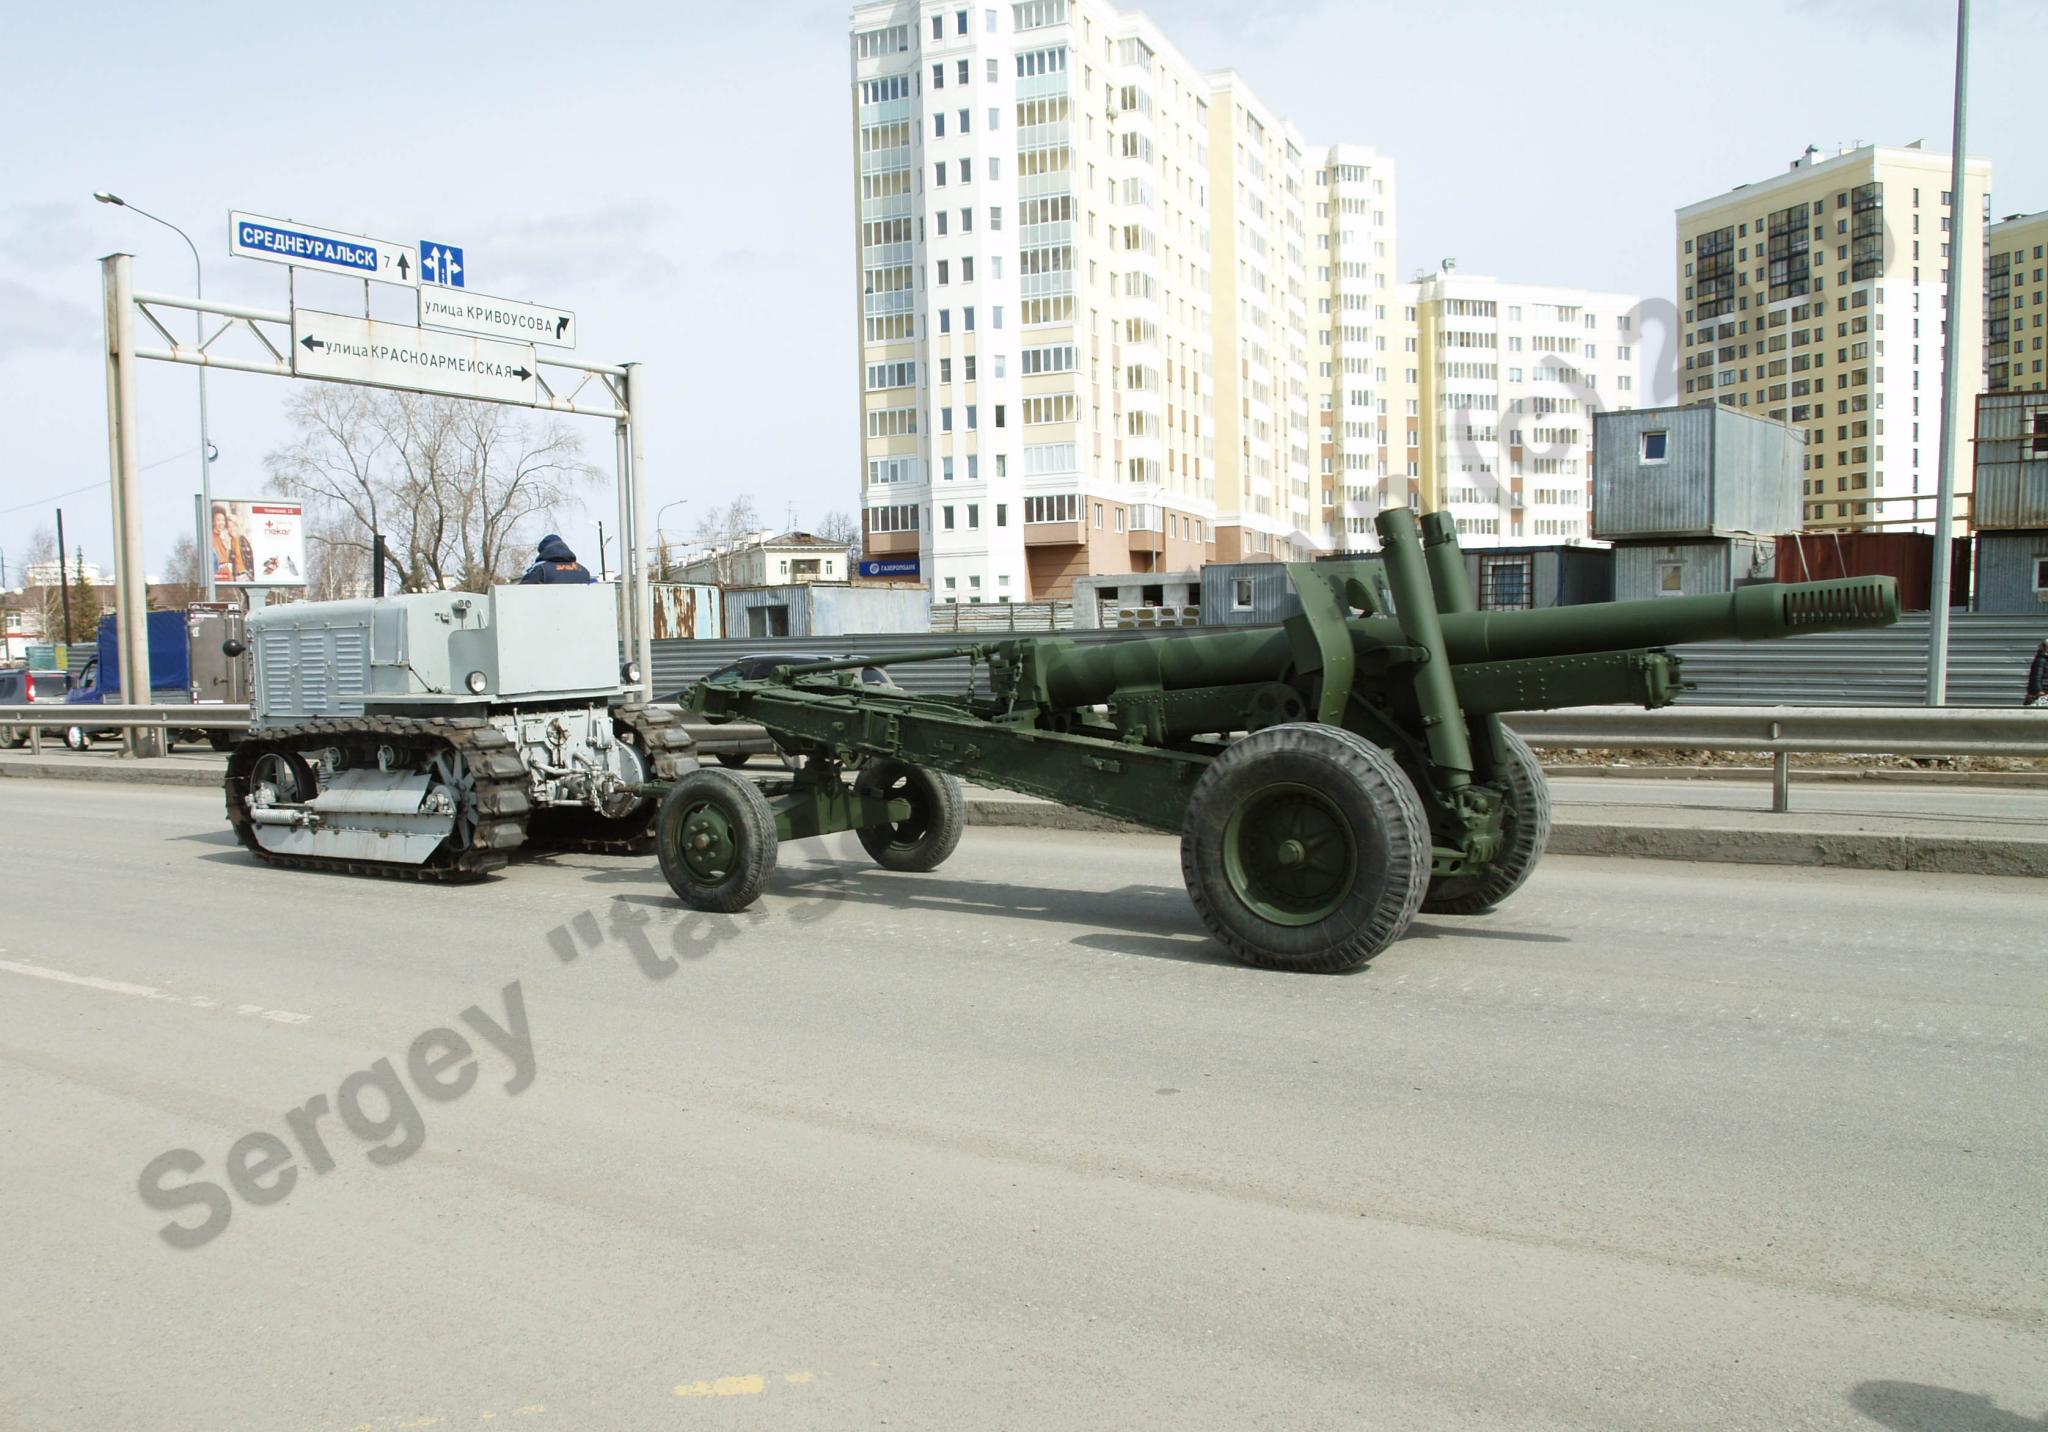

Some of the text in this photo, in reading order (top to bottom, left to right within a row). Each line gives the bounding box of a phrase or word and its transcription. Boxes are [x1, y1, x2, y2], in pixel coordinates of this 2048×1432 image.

[242, 227, 390, 268] СРЕДНЕУРАЛЬСК 7
[425, 301, 552, 332] улица КРИВОУСОВА
[325, 341, 368, 357] улица
